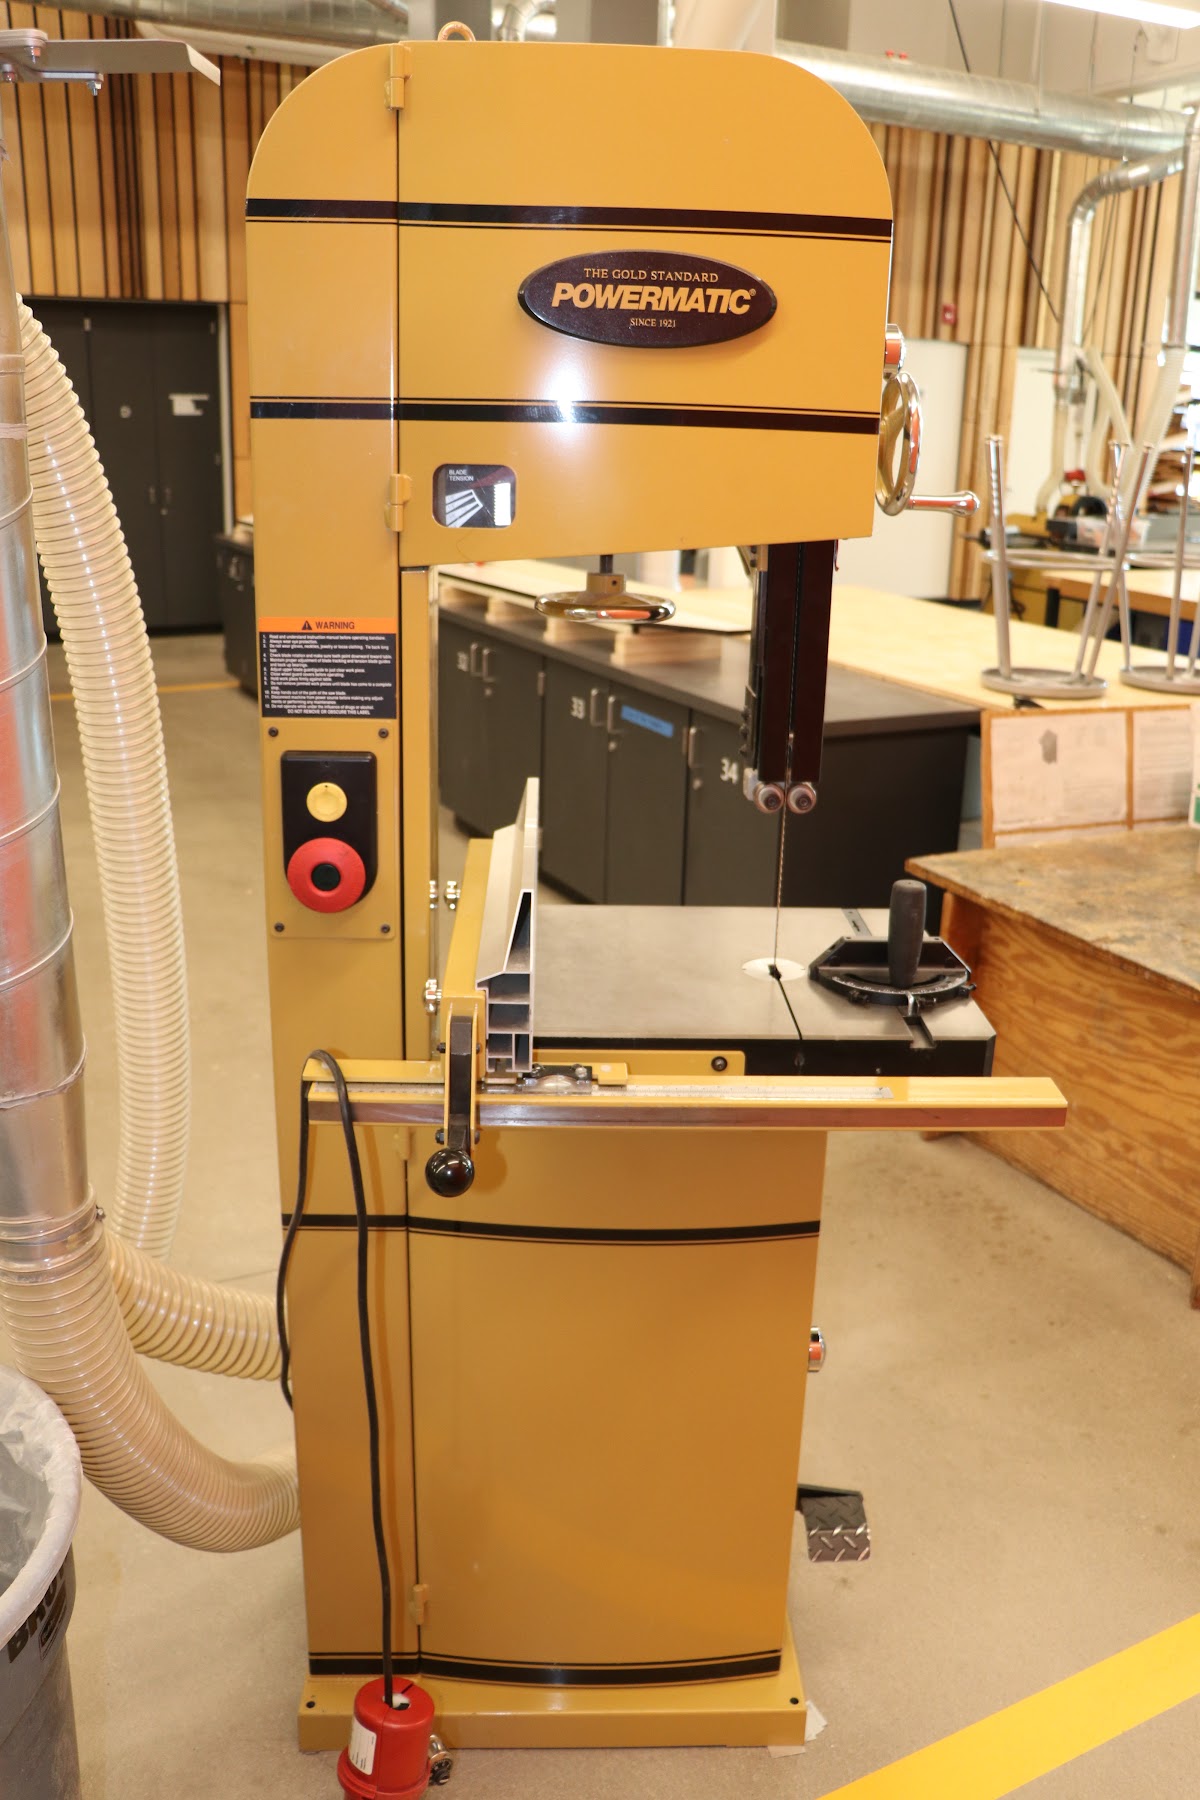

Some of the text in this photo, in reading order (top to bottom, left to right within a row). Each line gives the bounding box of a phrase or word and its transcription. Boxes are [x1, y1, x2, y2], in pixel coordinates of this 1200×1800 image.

[584, 268, 718, 282] THE GOLD STANDARD
[630, 318, 676, 328] SINCE 1921
[316, 622, 355, 630] WARNING
[720, 757, 738, 784] 34
